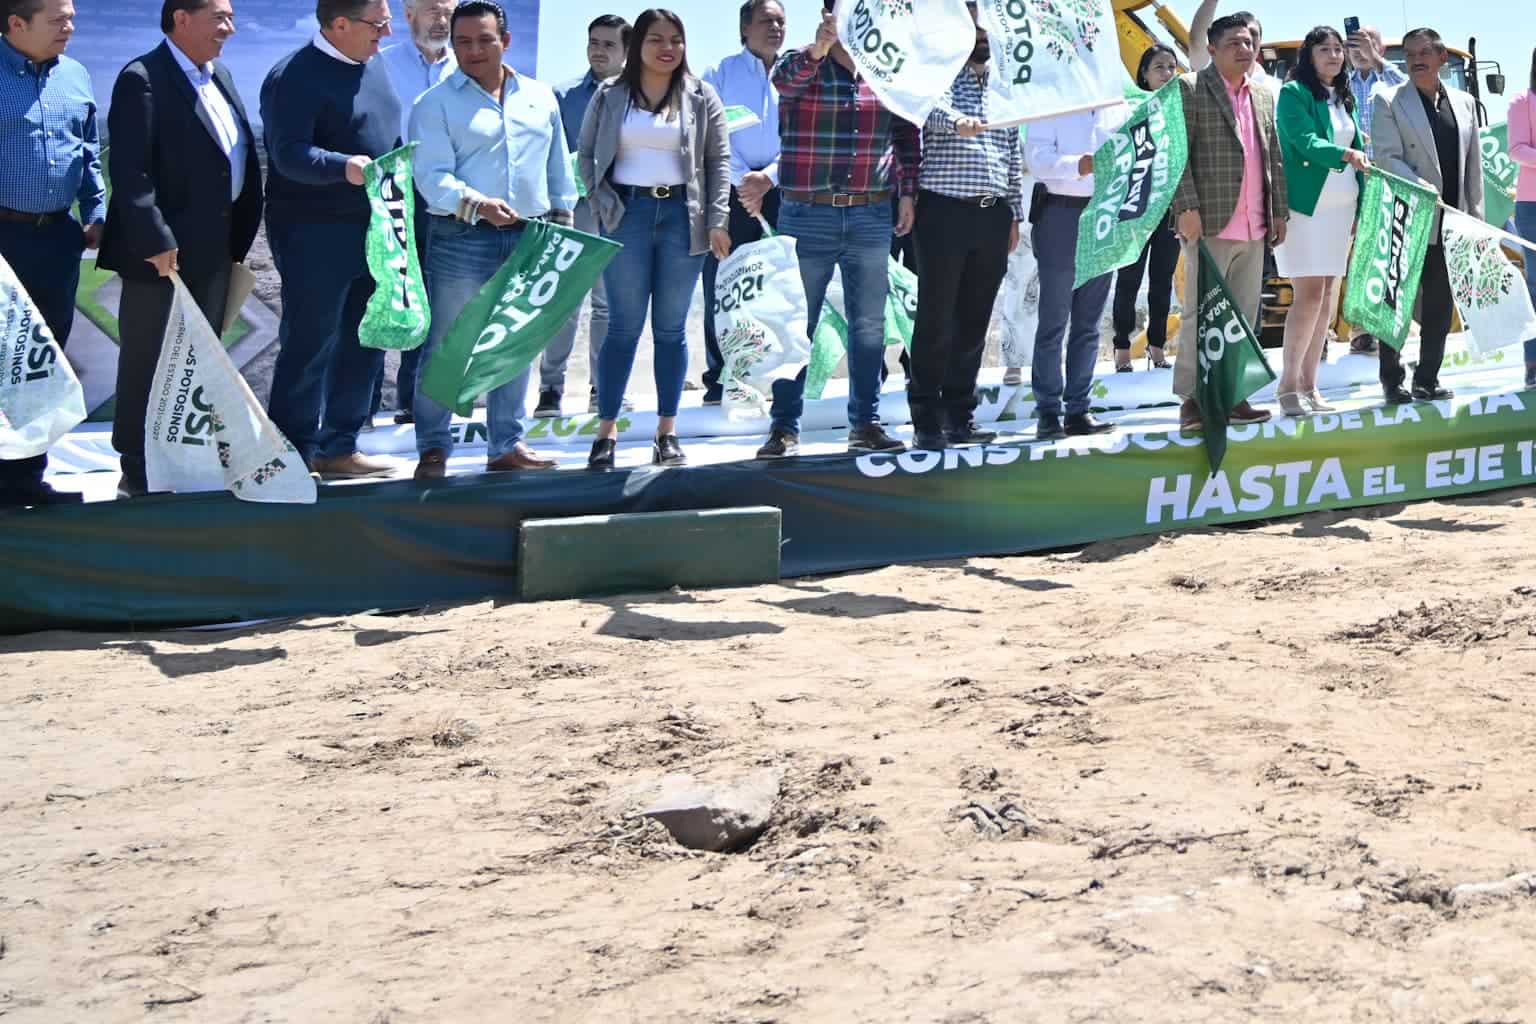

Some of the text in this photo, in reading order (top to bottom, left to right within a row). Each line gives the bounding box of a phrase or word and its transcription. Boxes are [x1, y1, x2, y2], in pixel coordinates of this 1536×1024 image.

[1095, 132, 1135, 241] APOYO
[1366, 179, 1393, 305] APOYO
[11, 309, 33, 385] POTOSINOS
[162, 363, 176, 397] ESTADO
[167, 368, 194, 443] POTOSINOS
[1313, 410, 1363, 433] DE
[1372, 405, 1421, 427] LA
[1145, 457, 1352, 523] HASTA
[1362, 465, 1406, 497] EL
[1425, 443, 1505, 489] EJE
